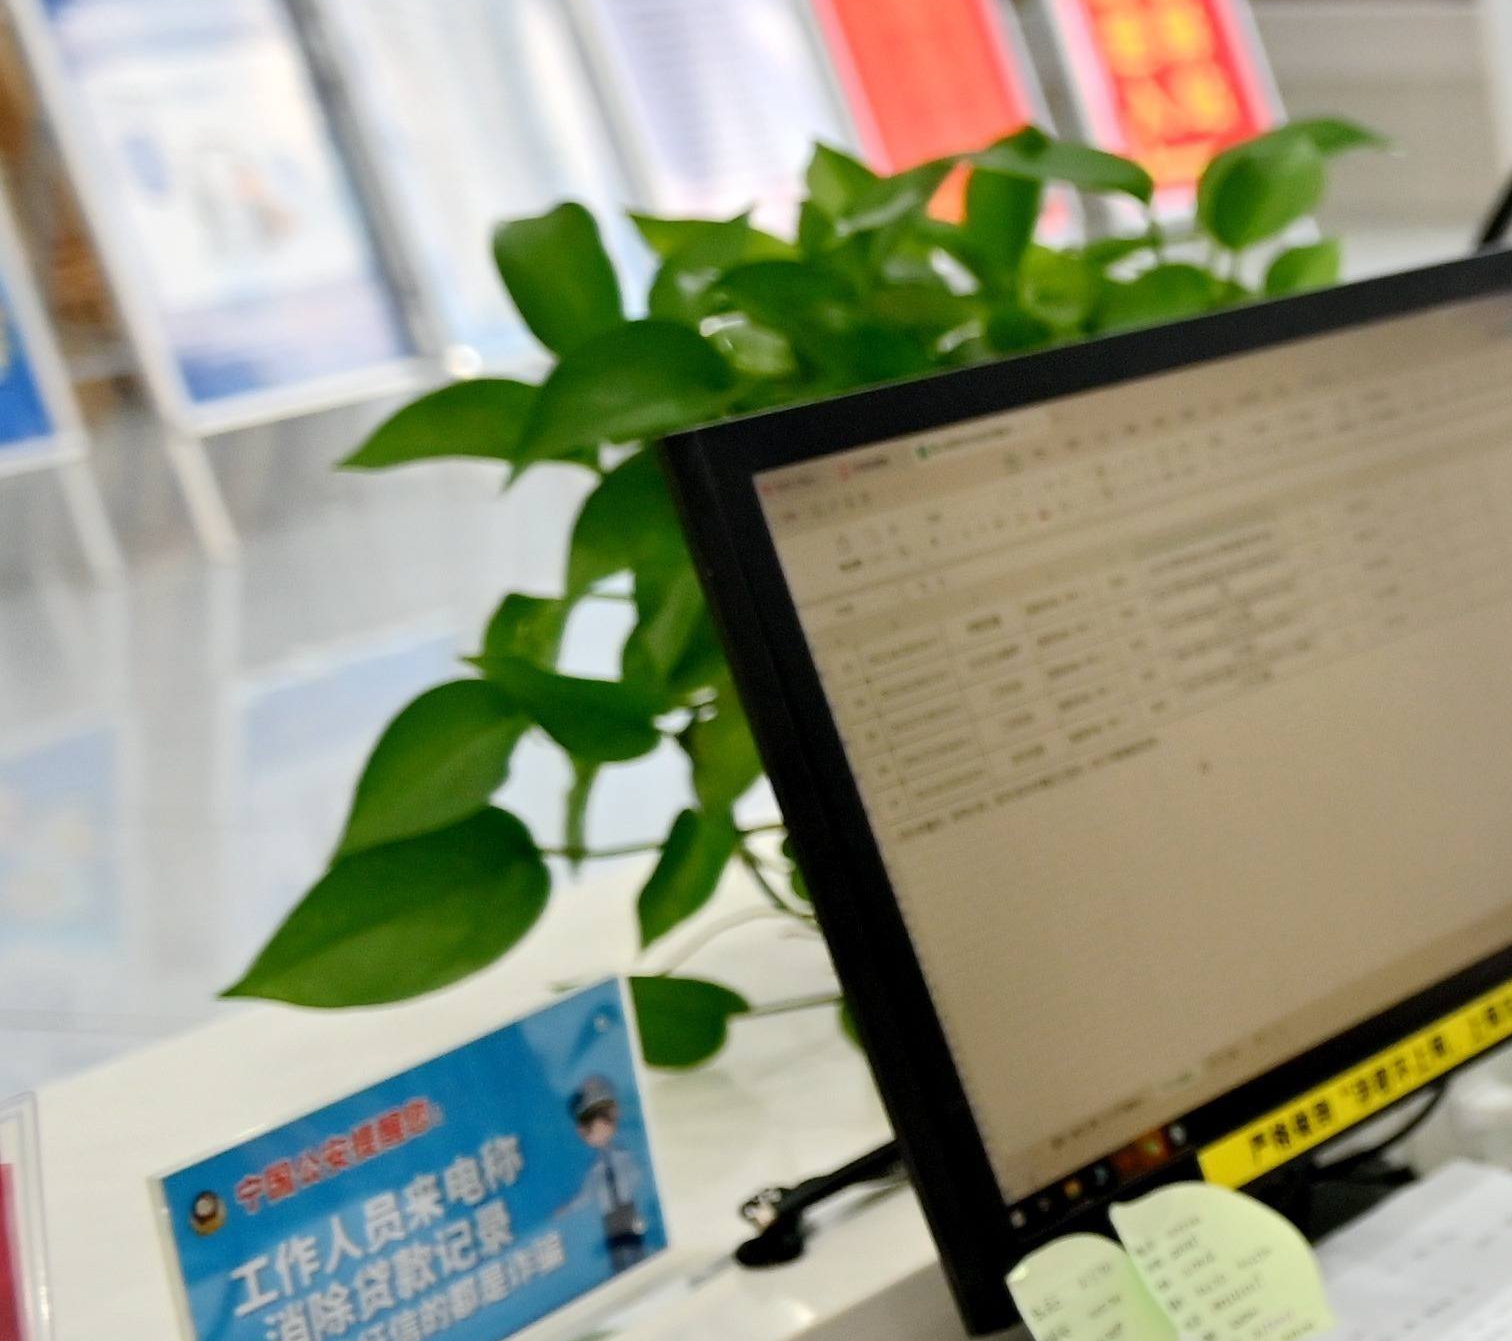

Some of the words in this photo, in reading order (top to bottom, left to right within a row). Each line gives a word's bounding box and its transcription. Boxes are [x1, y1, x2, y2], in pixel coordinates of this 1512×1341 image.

[230, 1134, 524, 1316] 工作人员来电称
